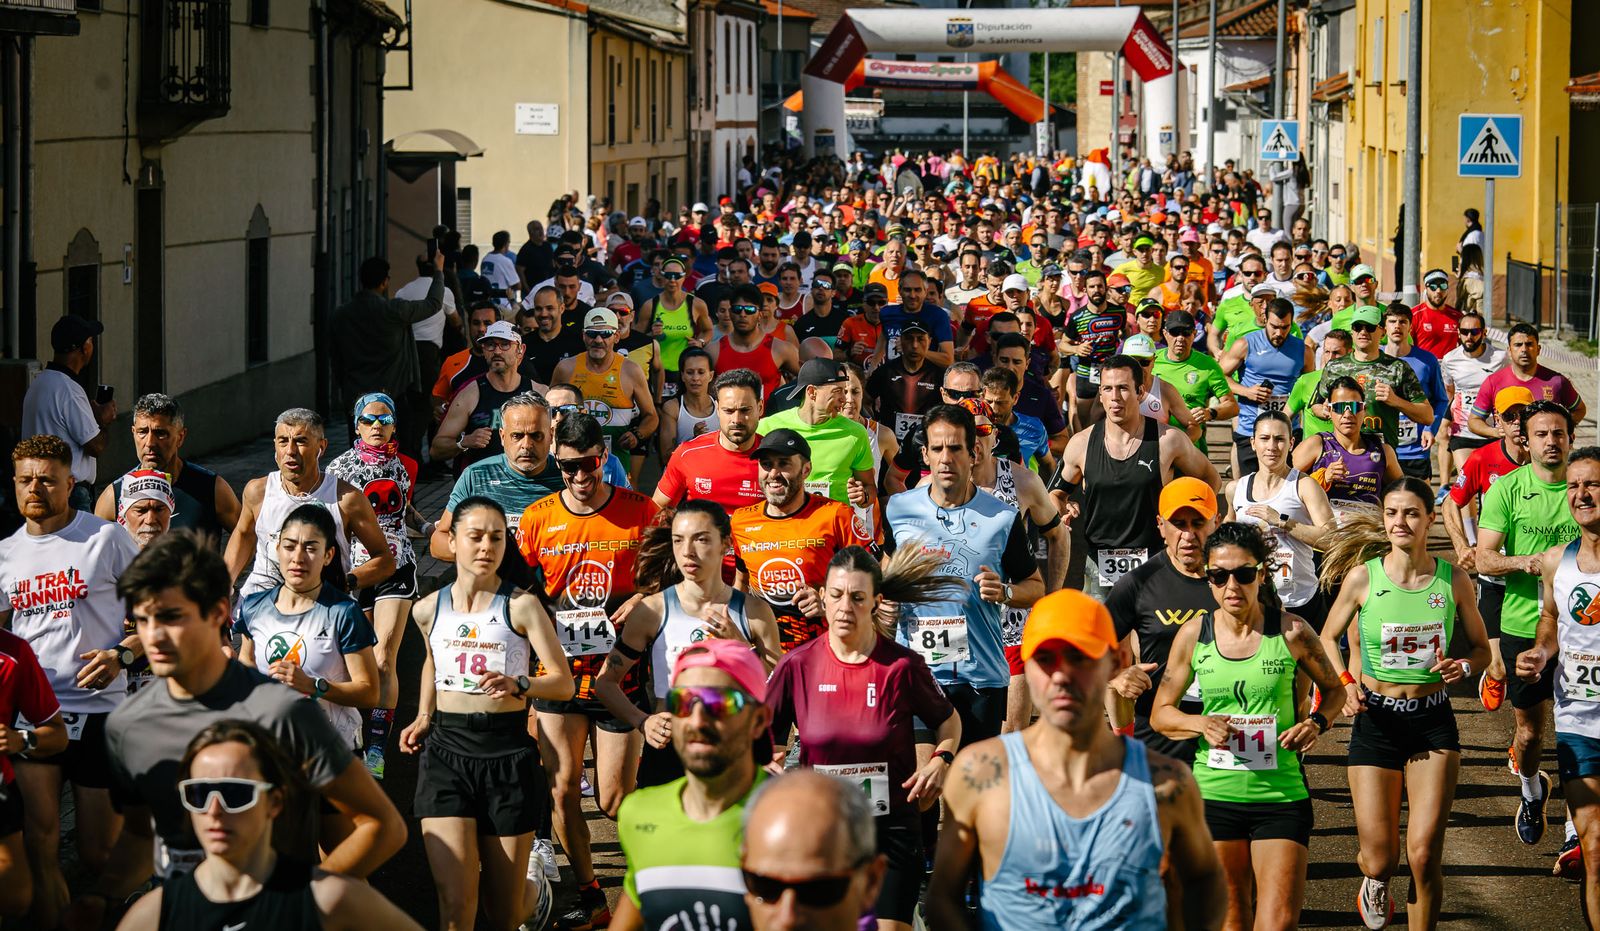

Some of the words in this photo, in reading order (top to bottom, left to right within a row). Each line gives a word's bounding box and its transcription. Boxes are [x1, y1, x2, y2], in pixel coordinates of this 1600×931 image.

[976, 23, 1033, 33] Diputación
[989, 37, 1043, 45] Salamanca
[574, 572, 606, 585] VISEU
[763, 568, 796, 581] VISEU
[575, 585, 606, 601] 360
[766, 581, 798, 596] 360
[564, 620, 610, 642] 114
[921, 629, 951, 650] 81
[1385, 634, 1441, 654] 15-1
[454, 652, 488, 676] 18
[1262, 659, 1285, 667] HeCa
[1261, 667, 1286, 675] TEAM
[1382, 696, 1419, 712] PRO
[840, 767, 859, 775] MEDIA
